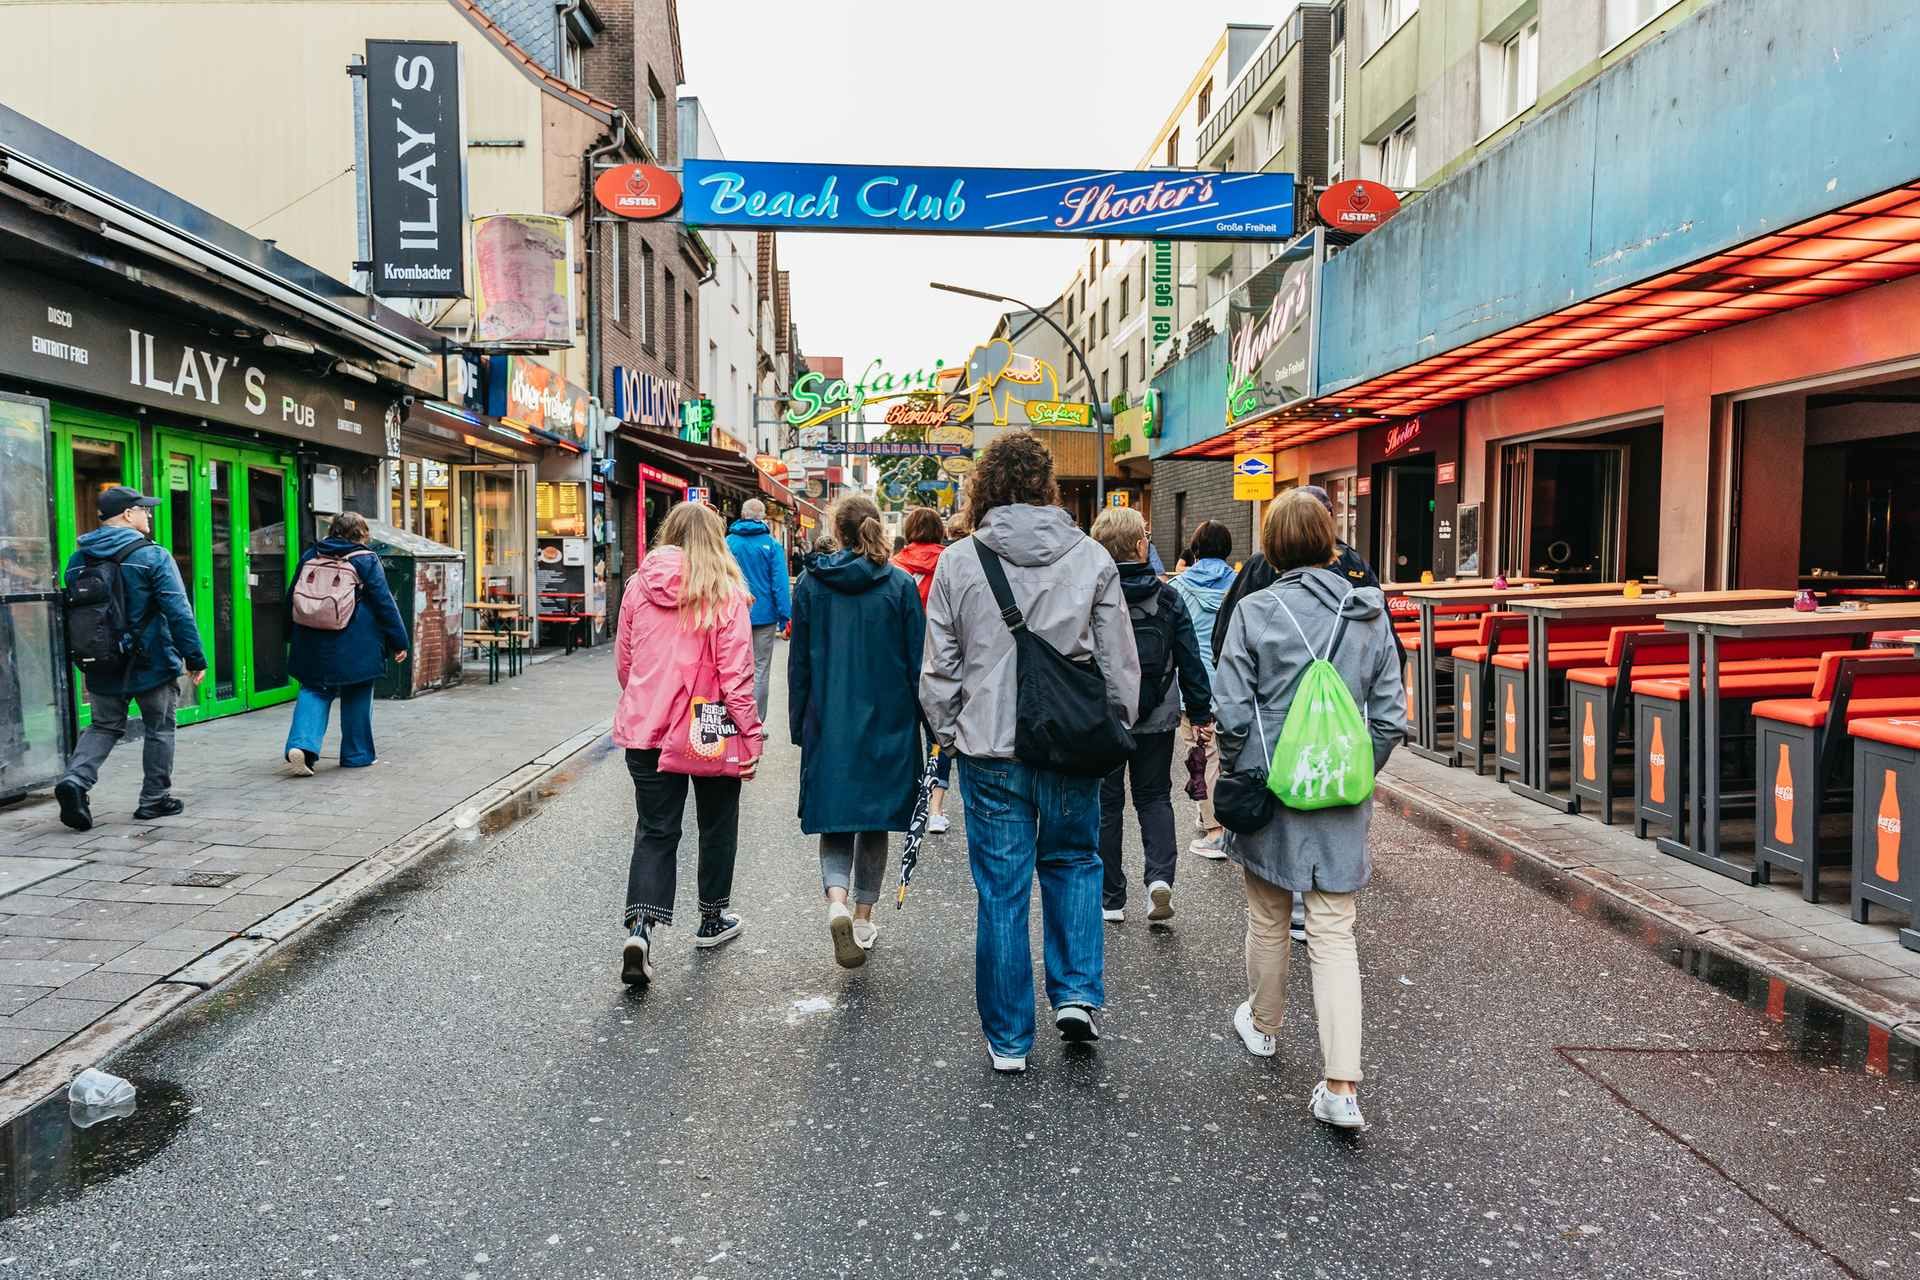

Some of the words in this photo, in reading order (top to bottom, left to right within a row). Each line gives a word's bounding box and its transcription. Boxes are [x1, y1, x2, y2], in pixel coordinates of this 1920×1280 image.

[391, 55, 439, 251] ILAY'S
[618, 197, 657, 207] ASTRA
[698, 171, 839, 220] Beach
[856, 176, 966, 222] Club
[1055, 177, 1215, 227] Shooter's
[1216, 222, 1243, 232] Große
[1245, 223, 1277, 233] Freiheit
[1340, 212, 1378, 222] ASTRA
[384, 263, 452, 280] Krombacher
[47, 306, 73, 328] DISCO
[32, 335, 70, 360] EINTRITT
[71, 345, 88, 365] FREI
[129, 328, 267, 416] ILAY'S
[621, 366, 682, 428] DOLLHOUSE
[787, 358, 944, 424] Safari
[886, 403, 955, 431] Bierdorf
[1030, 402, 1084, 423] Safari
[846, 443, 938, 454] SPIELHALLE
